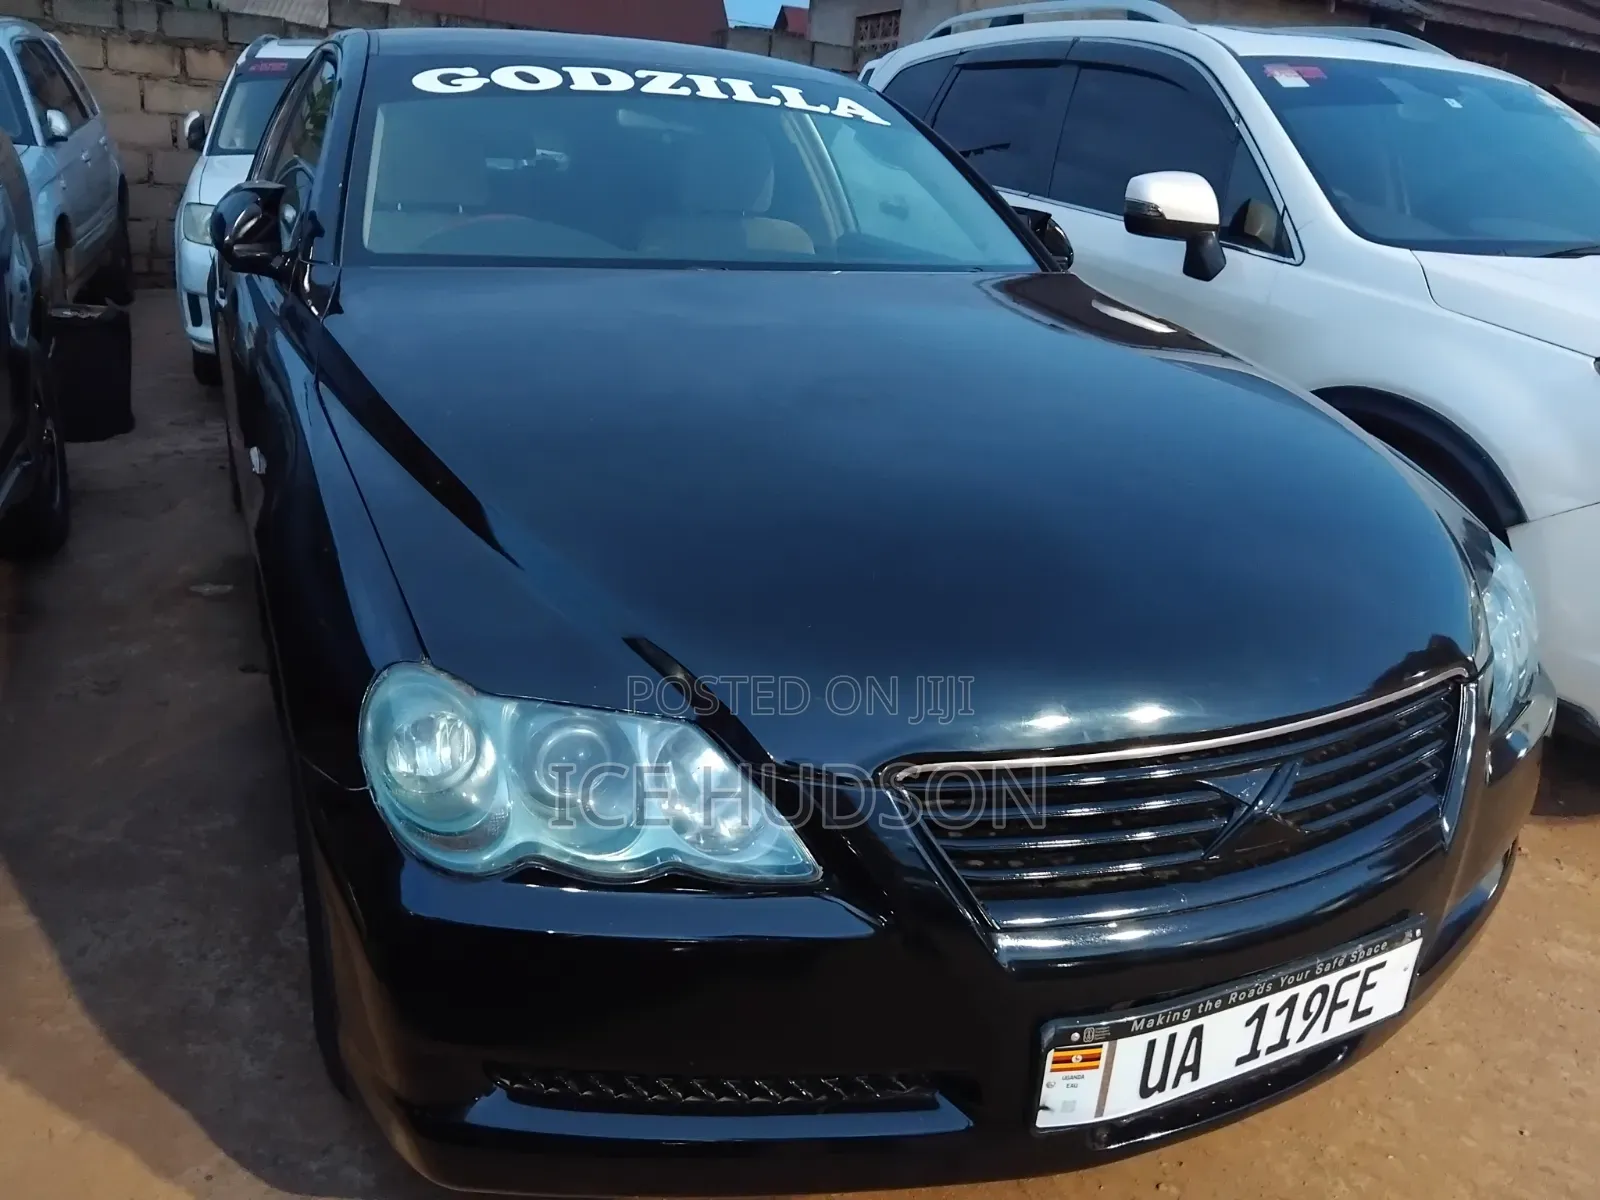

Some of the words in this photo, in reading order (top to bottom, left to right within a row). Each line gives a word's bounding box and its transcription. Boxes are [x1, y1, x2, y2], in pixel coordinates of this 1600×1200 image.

[412, 65, 891, 126] GODZILLA
[1130, 1008, 1191, 1032] Making
[1198, 998, 1222, 1014] the
[1228, 981, 1273, 1005] Roads
[1280, 969, 1310, 987] Your
[1315, 956, 1346, 975] Safe
[1350, 941, 1388, 963] Space
[1139, 1024, 1205, 1099] UA
[1235, 960, 1388, 1067] 119FE
